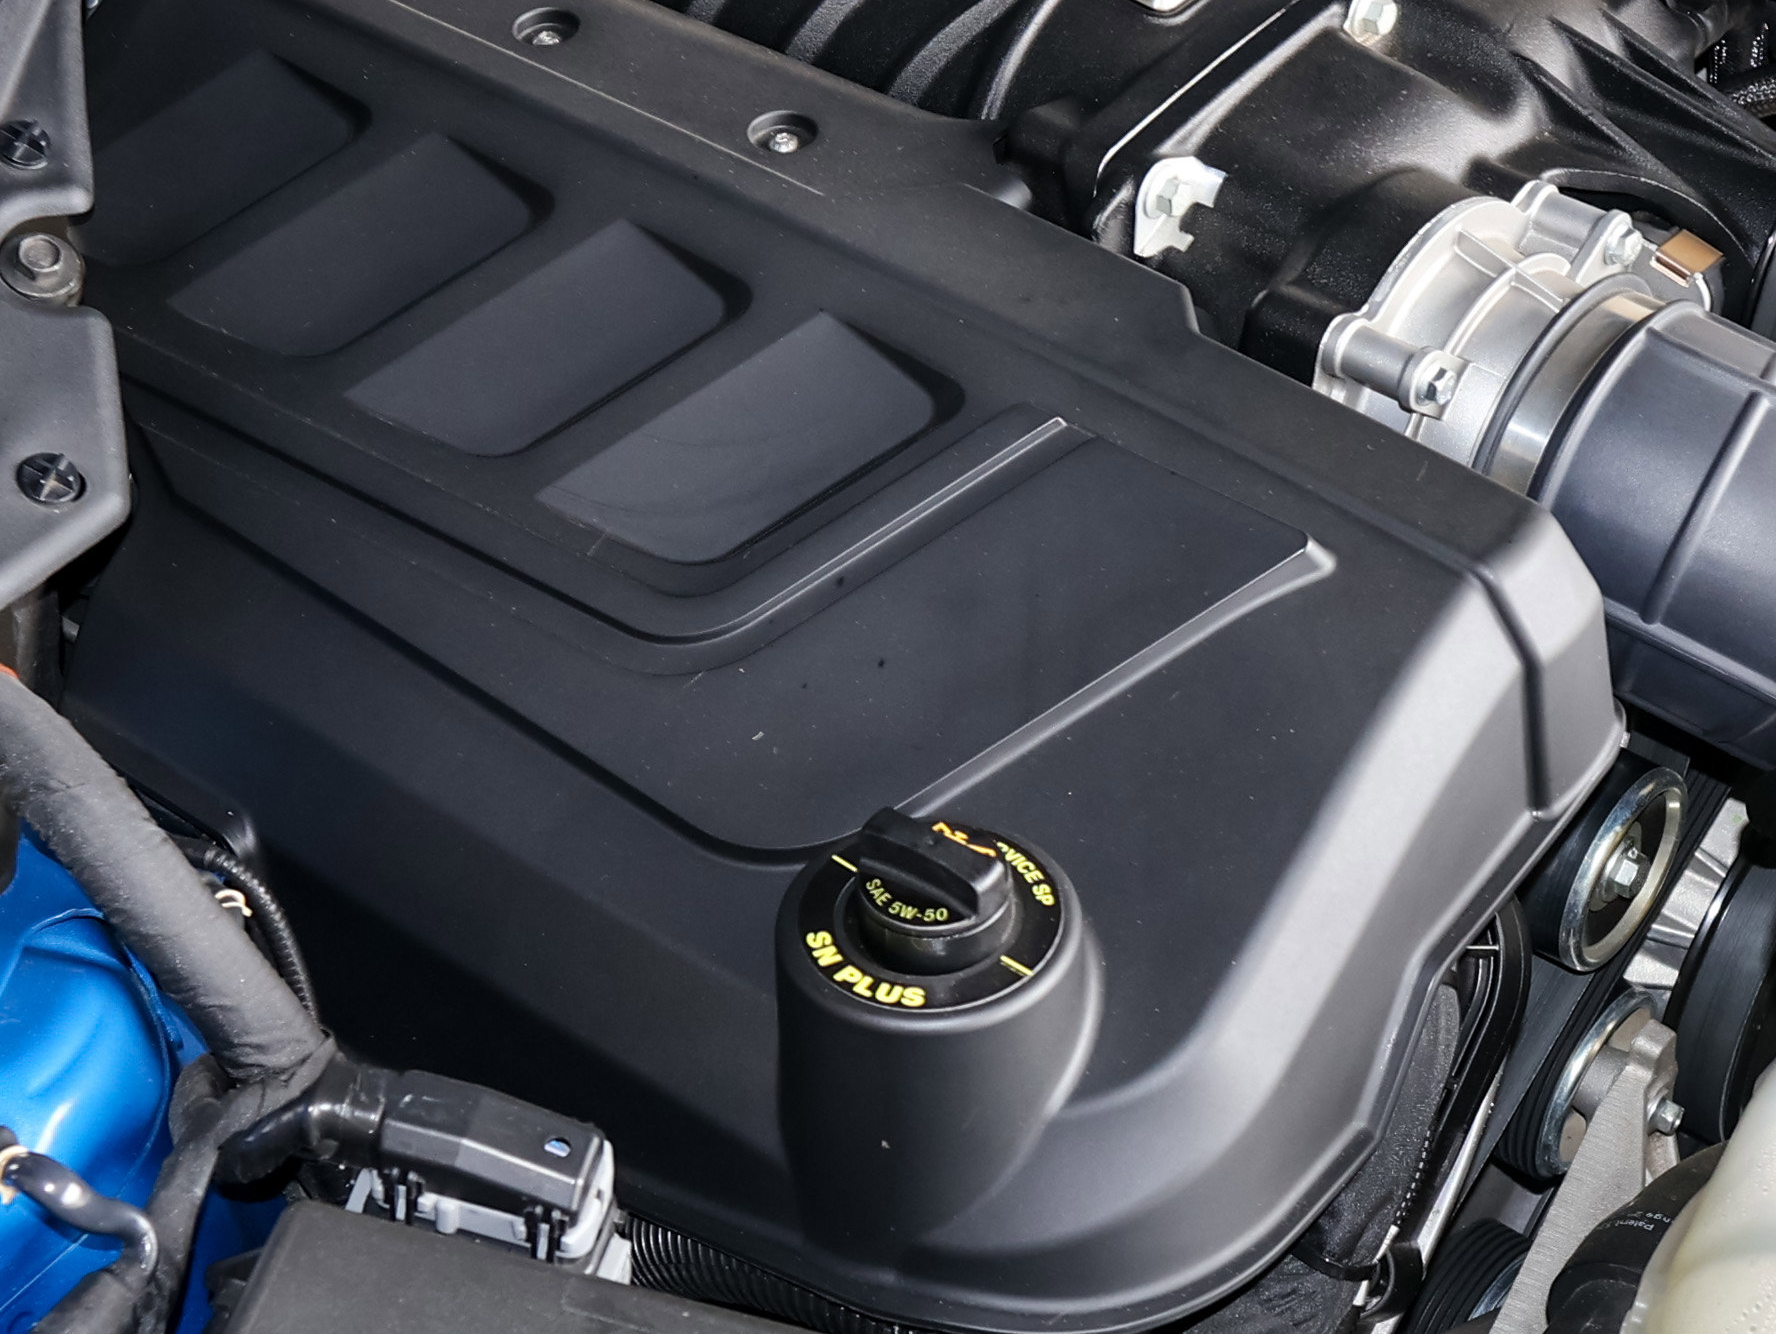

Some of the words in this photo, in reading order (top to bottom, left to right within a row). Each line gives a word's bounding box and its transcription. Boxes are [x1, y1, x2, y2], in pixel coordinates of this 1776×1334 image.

[865, 878, 894, 907] SAE
[888, 901, 950, 922] 5W-50
[1031, 883, 1056, 907] SP
[805, 930, 844, 967] SN
[832, 965, 927, 1008] PLUS
